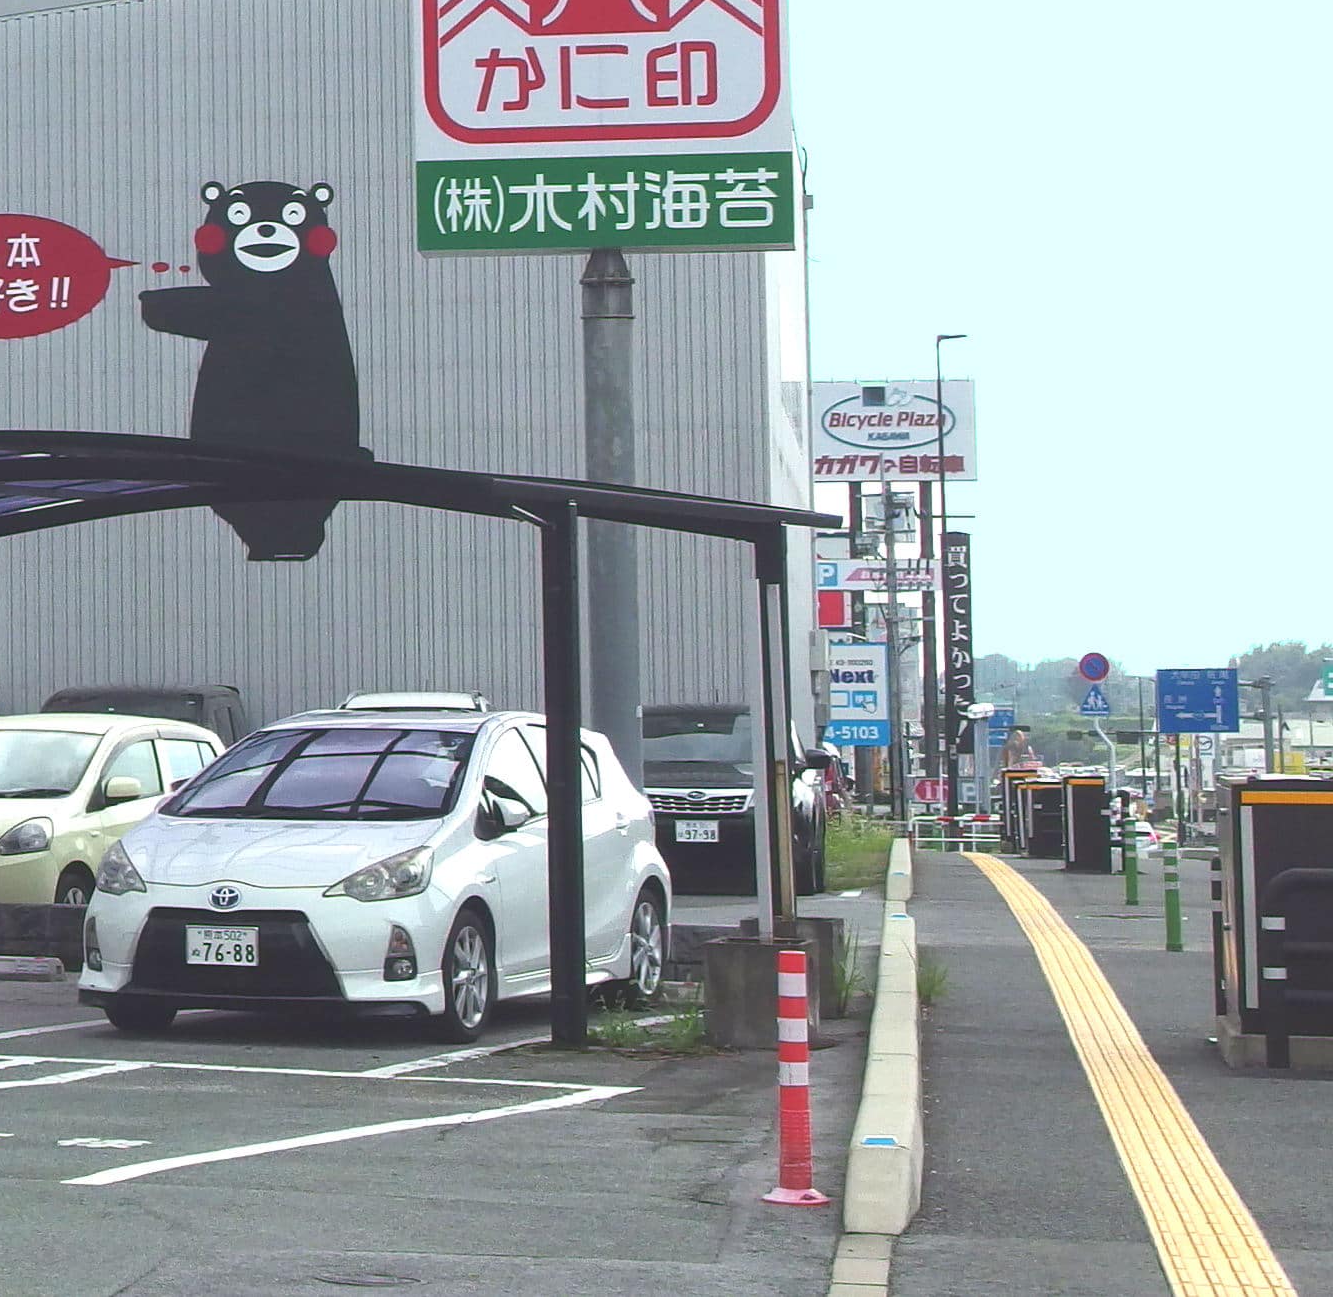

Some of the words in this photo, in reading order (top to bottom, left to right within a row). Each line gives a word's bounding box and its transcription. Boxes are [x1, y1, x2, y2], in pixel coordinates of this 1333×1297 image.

[474, 40, 718, 113] かに印
[433, 167, 779, 236] (株)木村海苔
[829, 412, 893, 430] Bicycle
[202, 942, 255, 962] 76-88
